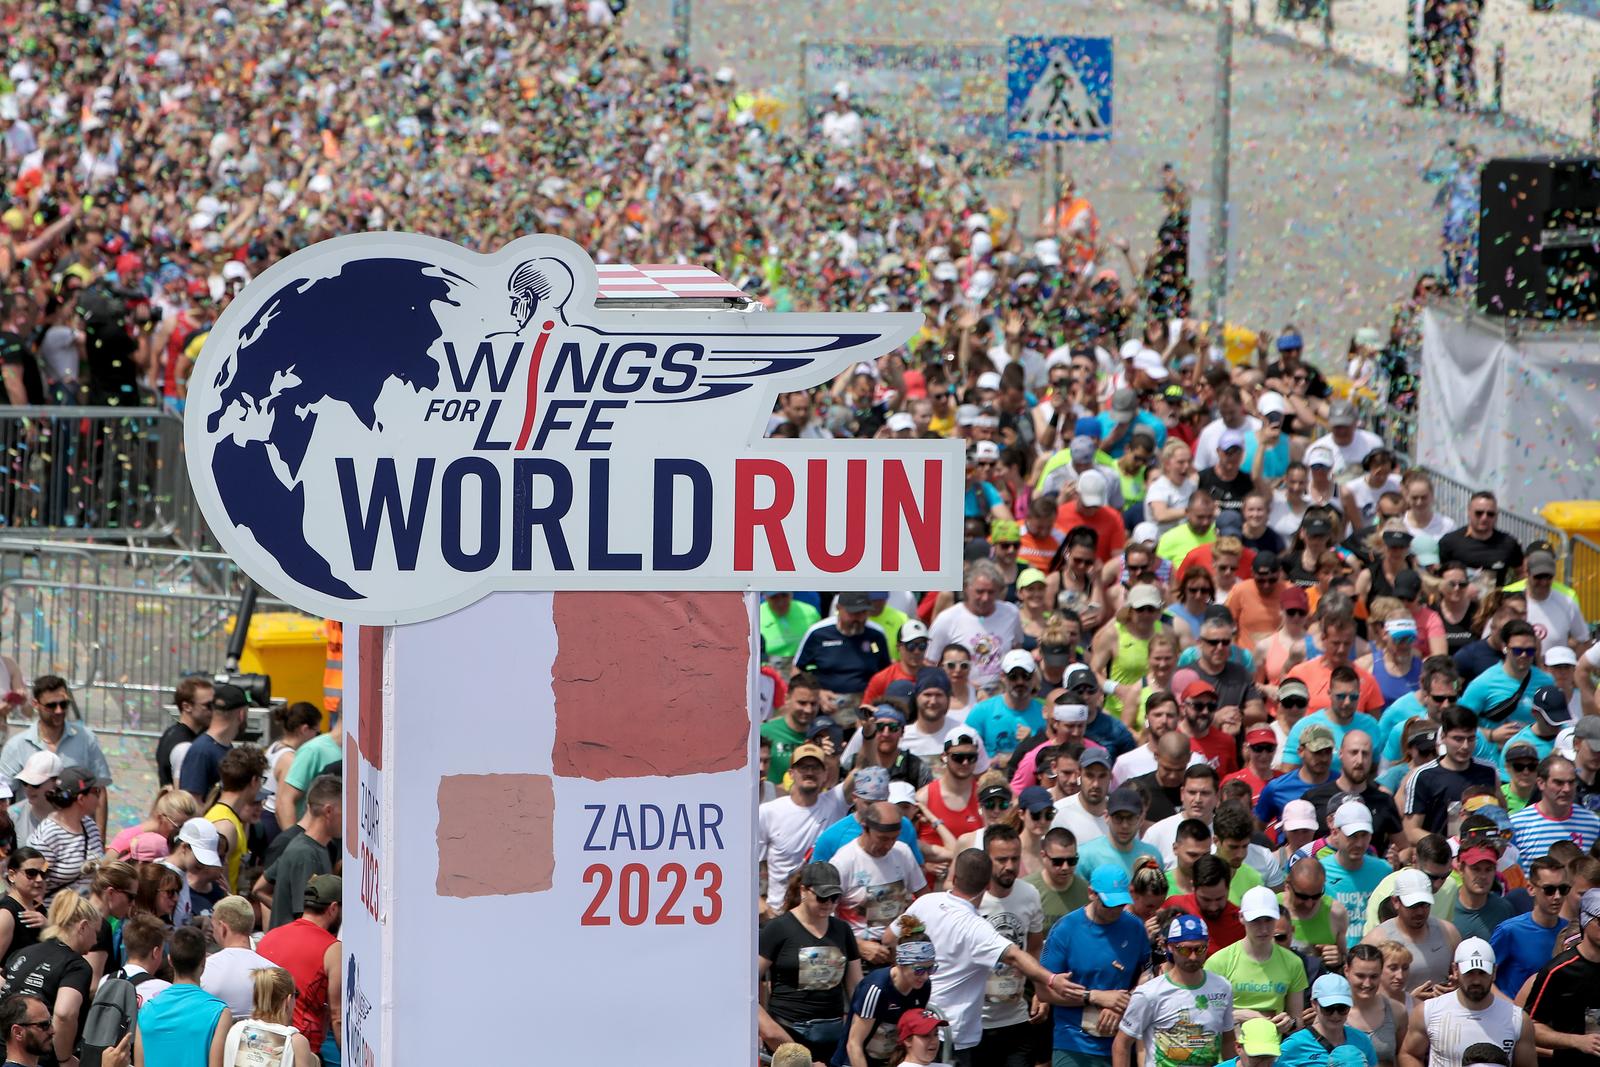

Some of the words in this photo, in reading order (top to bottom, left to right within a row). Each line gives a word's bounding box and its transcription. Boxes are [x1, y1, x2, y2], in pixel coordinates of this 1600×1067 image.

[424, 400, 480, 421] FOR
[473, 400, 628, 450] LIFE
[335, 456, 713, 572] WORLD
[733, 458, 943, 573] RUN
[583, 804, 724, 851] ZADAR
[361, 841, 378, 922] 2023
[581, 862, 723, 926] 2023
[1235, 981, 1273, 993] unicef
